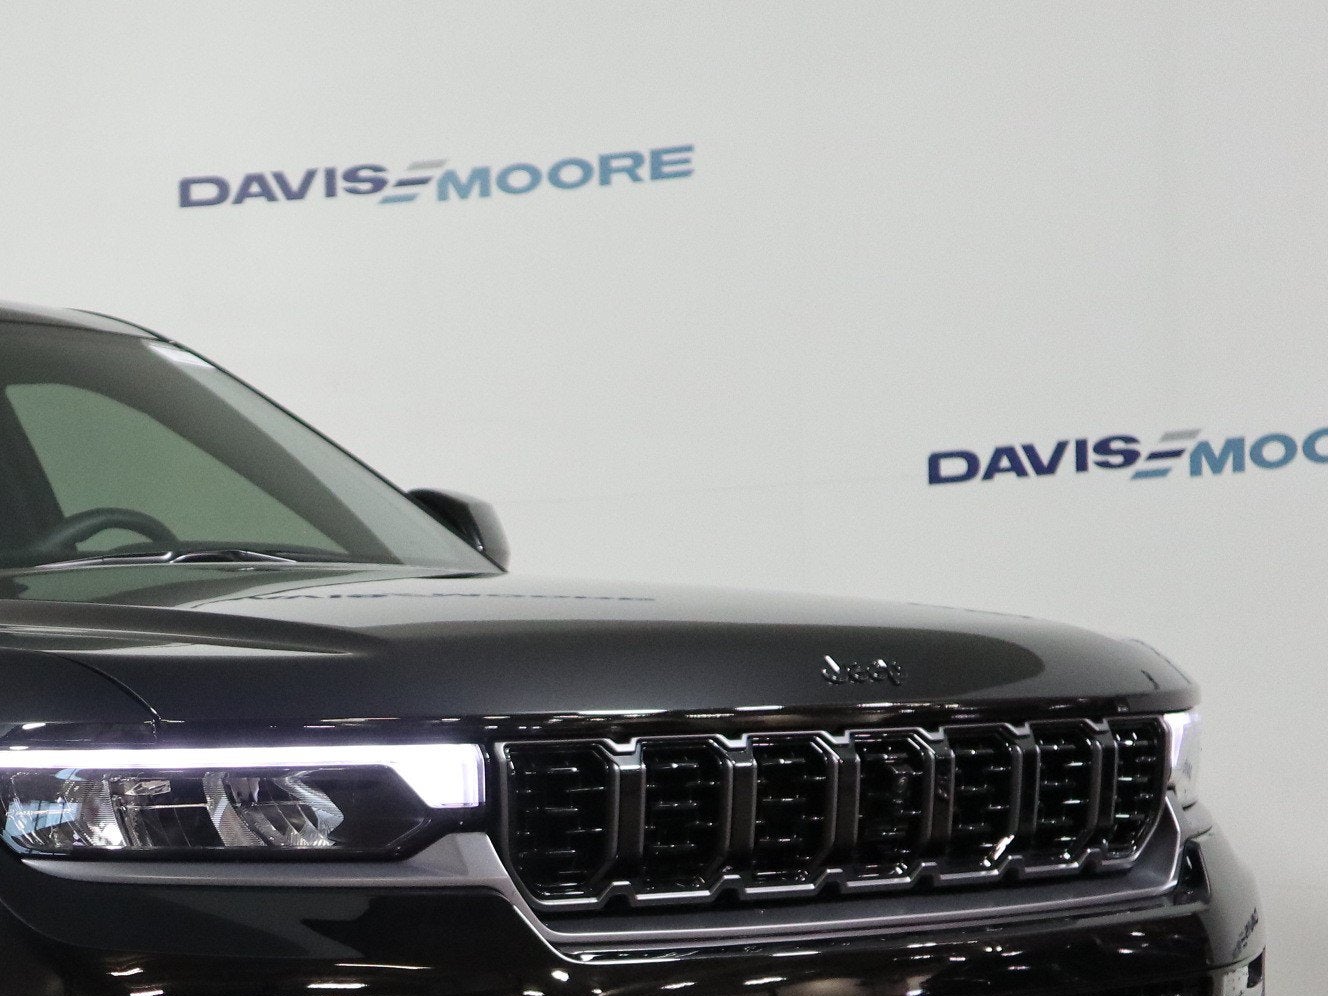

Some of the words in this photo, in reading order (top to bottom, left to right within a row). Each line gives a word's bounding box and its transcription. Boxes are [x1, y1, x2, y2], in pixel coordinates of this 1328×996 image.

[178, 164, 390, 208] DAVIS
[437, 144, 695, 202] MOORE
[927, 434, 1141, 486] DAVIS
